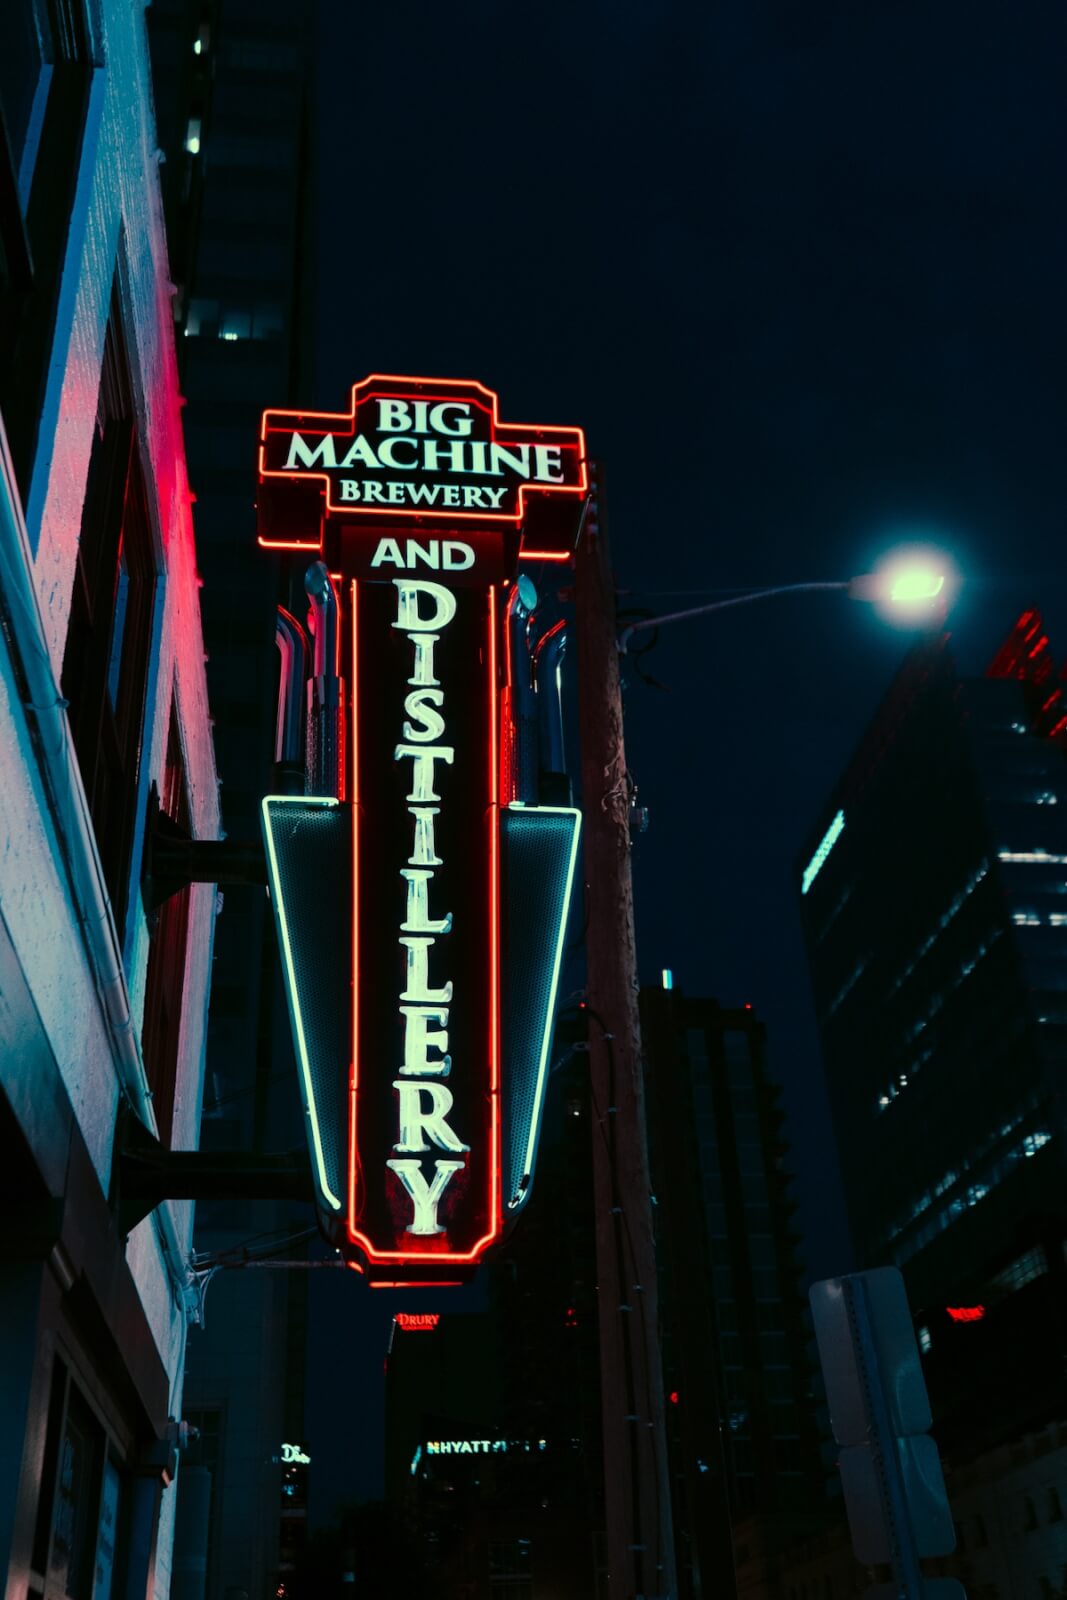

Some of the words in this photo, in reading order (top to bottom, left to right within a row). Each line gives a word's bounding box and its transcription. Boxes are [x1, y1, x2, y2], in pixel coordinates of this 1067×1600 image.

[376, 399, 474, 437] BIG
[281, 431, 565, 484] MACHINE
[339, 479, 509, 509] BREWERY
[370, 537, 476, 571] AND
[386, 577, 471, 1235] DISTILLERY
[400, 1313, 439, 1325] DRURY
